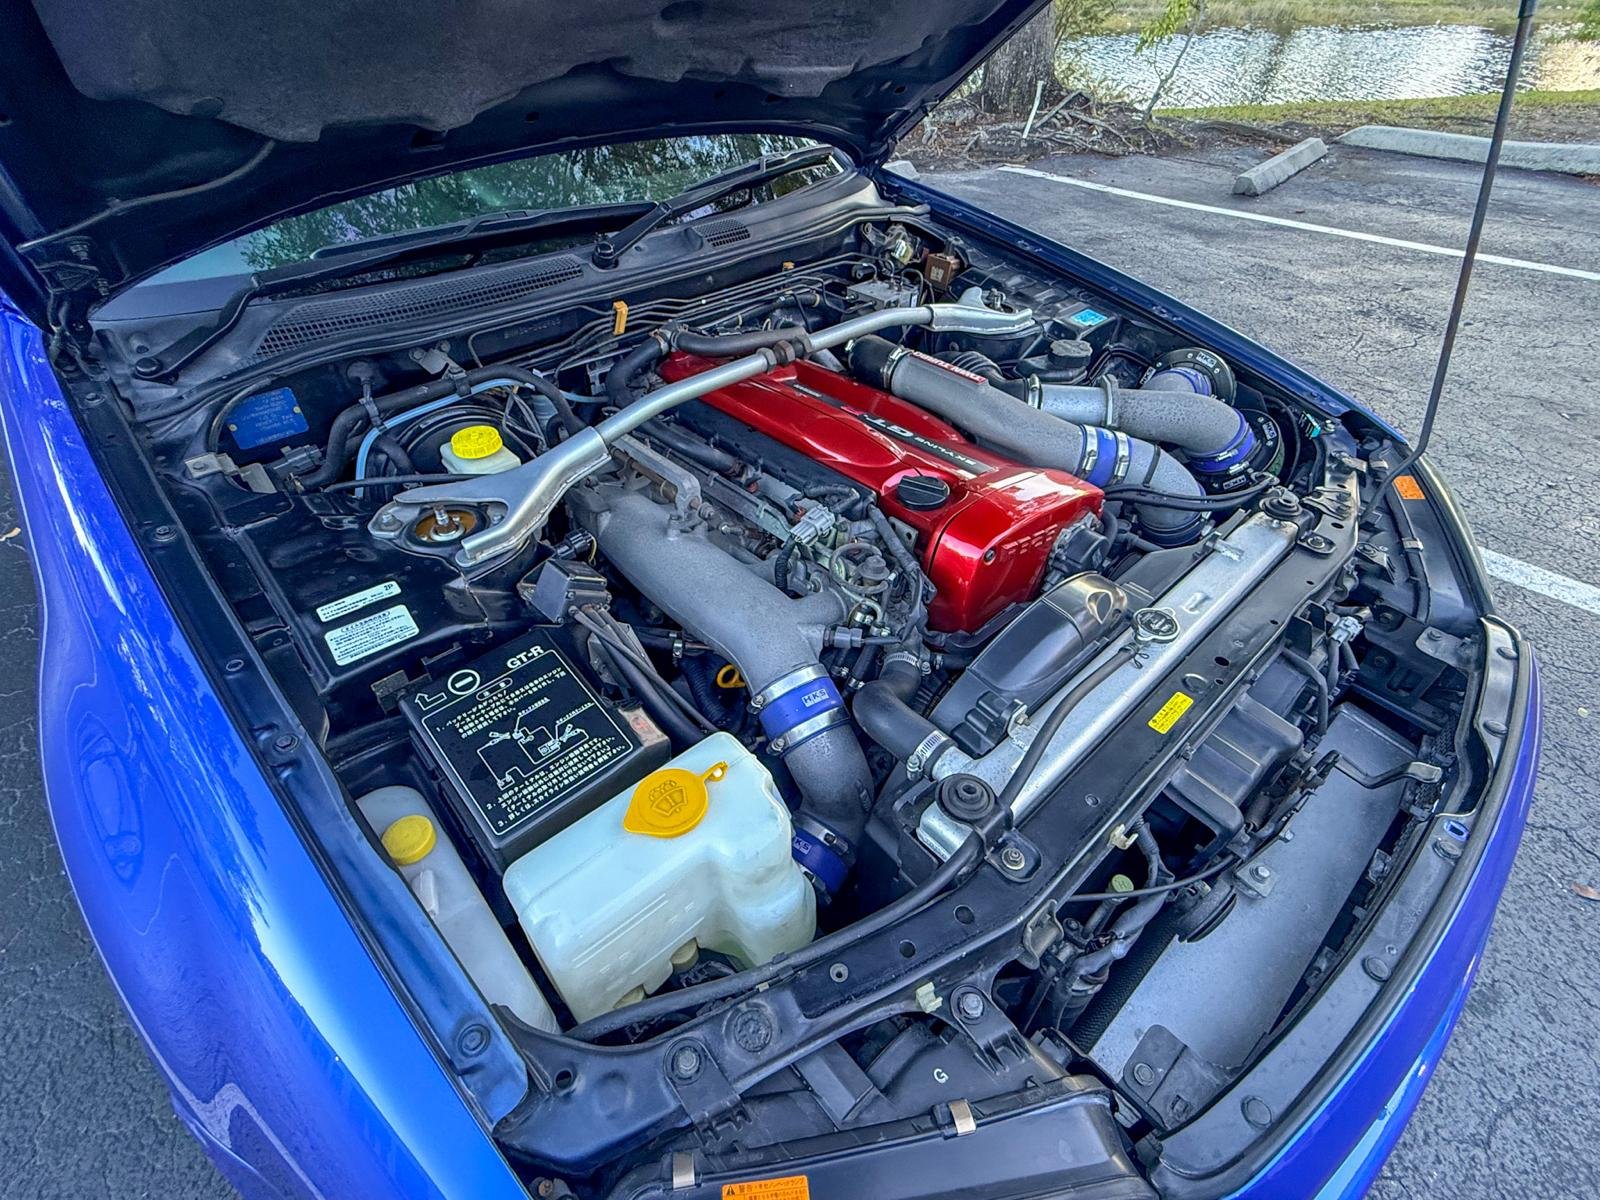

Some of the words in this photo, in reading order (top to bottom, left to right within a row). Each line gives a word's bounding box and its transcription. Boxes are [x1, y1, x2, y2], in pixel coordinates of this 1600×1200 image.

[841, 405, 914, 438] GT-R
[913, 436, 977, 466] SKYLINE
[506, 645, 544, 669] GT-R
[803, 689, 826, 704] HKS
[933, 1067, 948, 1083] G
